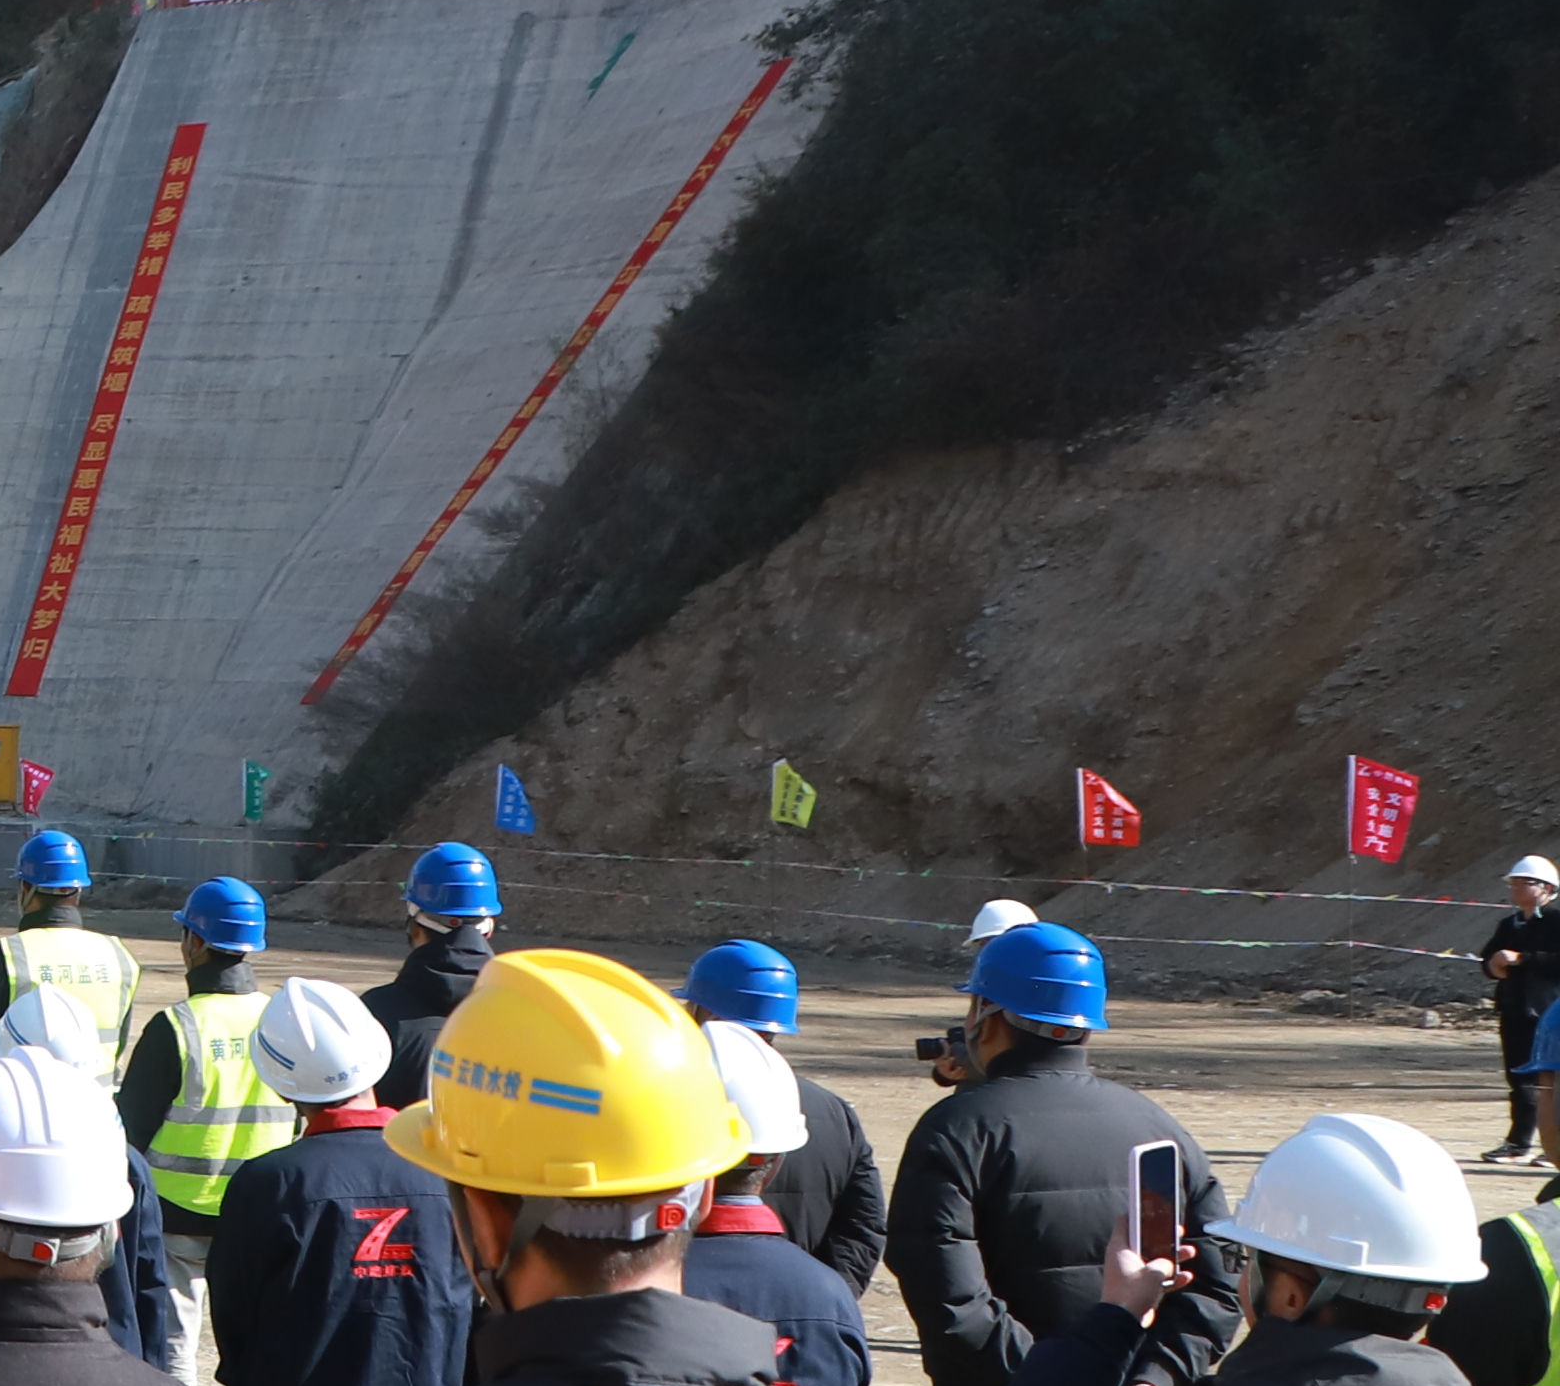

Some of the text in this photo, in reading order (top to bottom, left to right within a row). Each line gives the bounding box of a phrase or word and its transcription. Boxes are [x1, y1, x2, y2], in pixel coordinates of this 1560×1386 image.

[137, 156, 194, 276] 利民多举措
[22, 413, 116, 660] 尽显惠民福祉大梦归
[38, 964, 110, 984] 黄河监理
[456, 1058, 523, 1101] 云南水投
